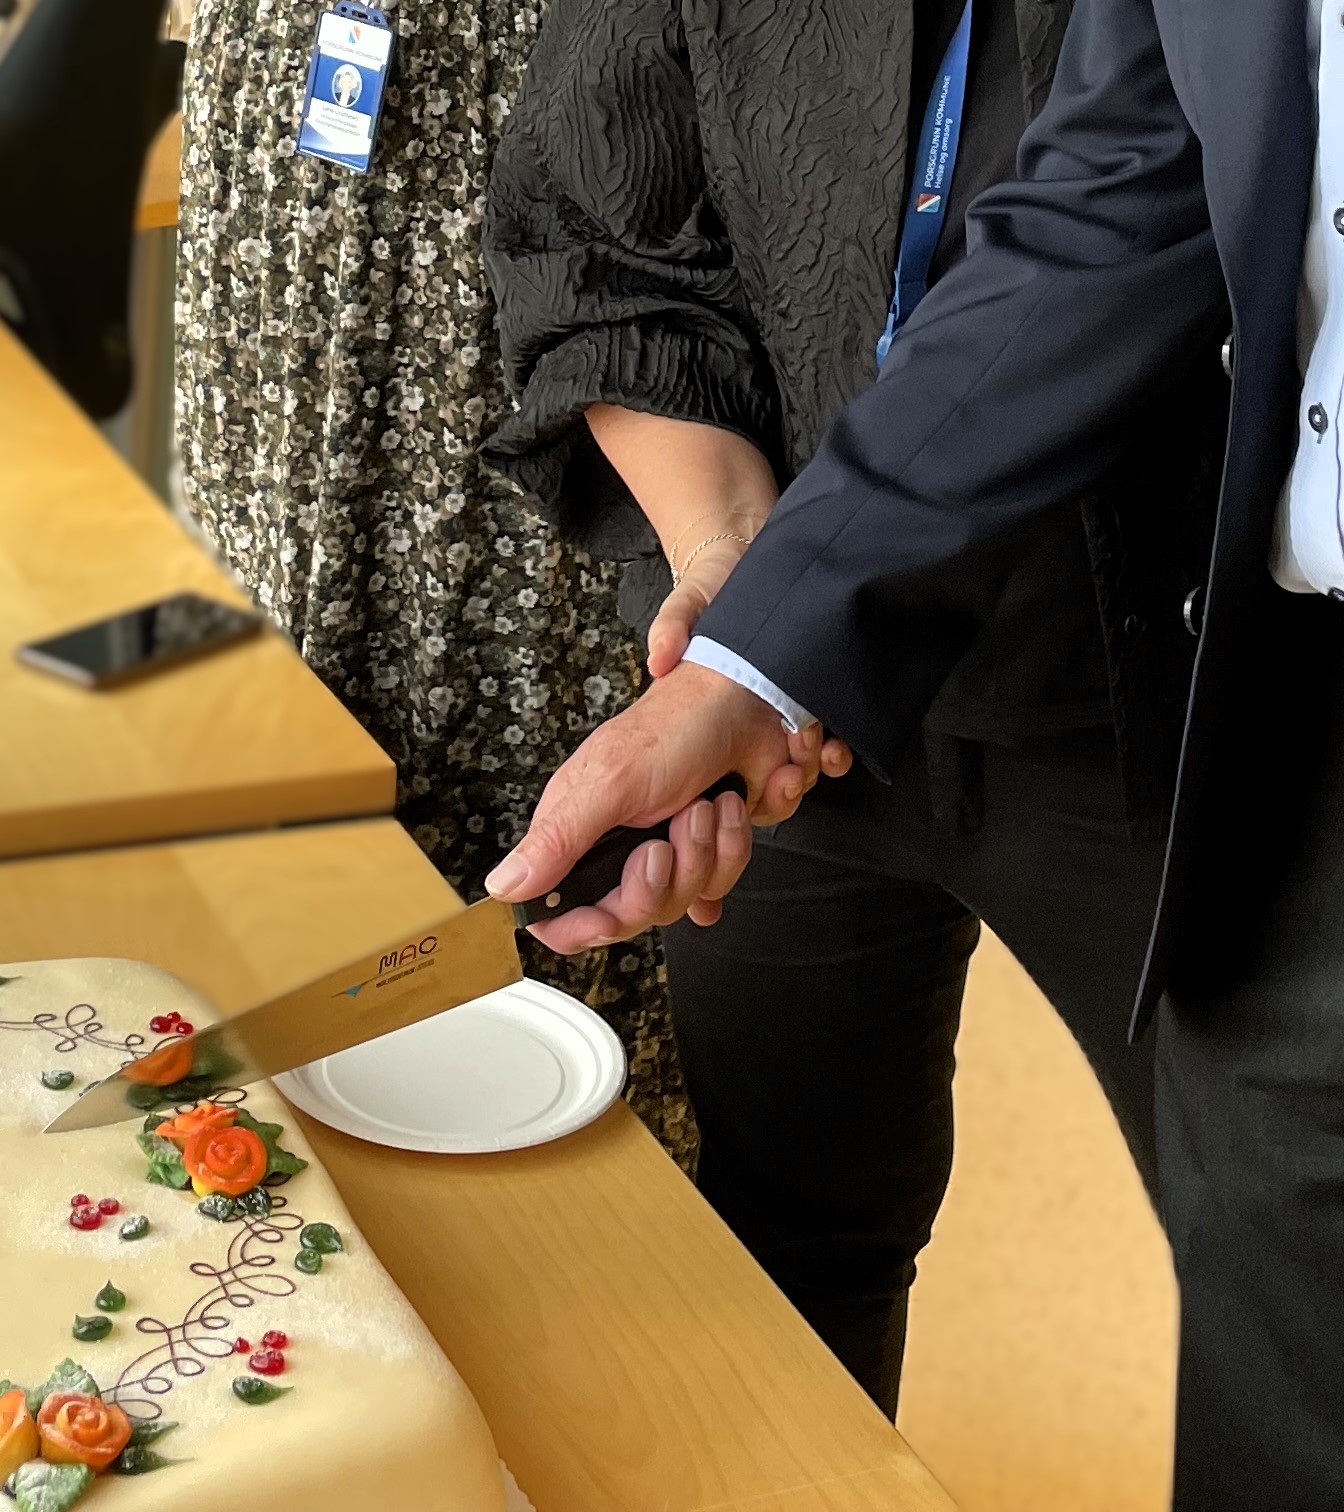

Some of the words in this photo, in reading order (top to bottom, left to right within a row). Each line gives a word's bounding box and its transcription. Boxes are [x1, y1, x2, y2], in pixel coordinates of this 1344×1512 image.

[924, 128, 941, 188] PORSGRUNN
[935, 75, 951, 125] KOMMUNE
[942, 118, 953, 151] omsorg
[939, 151, 949, 164] og
[934, 164, 945, 189] Helse
[378, 935, 438, 975] MAC
